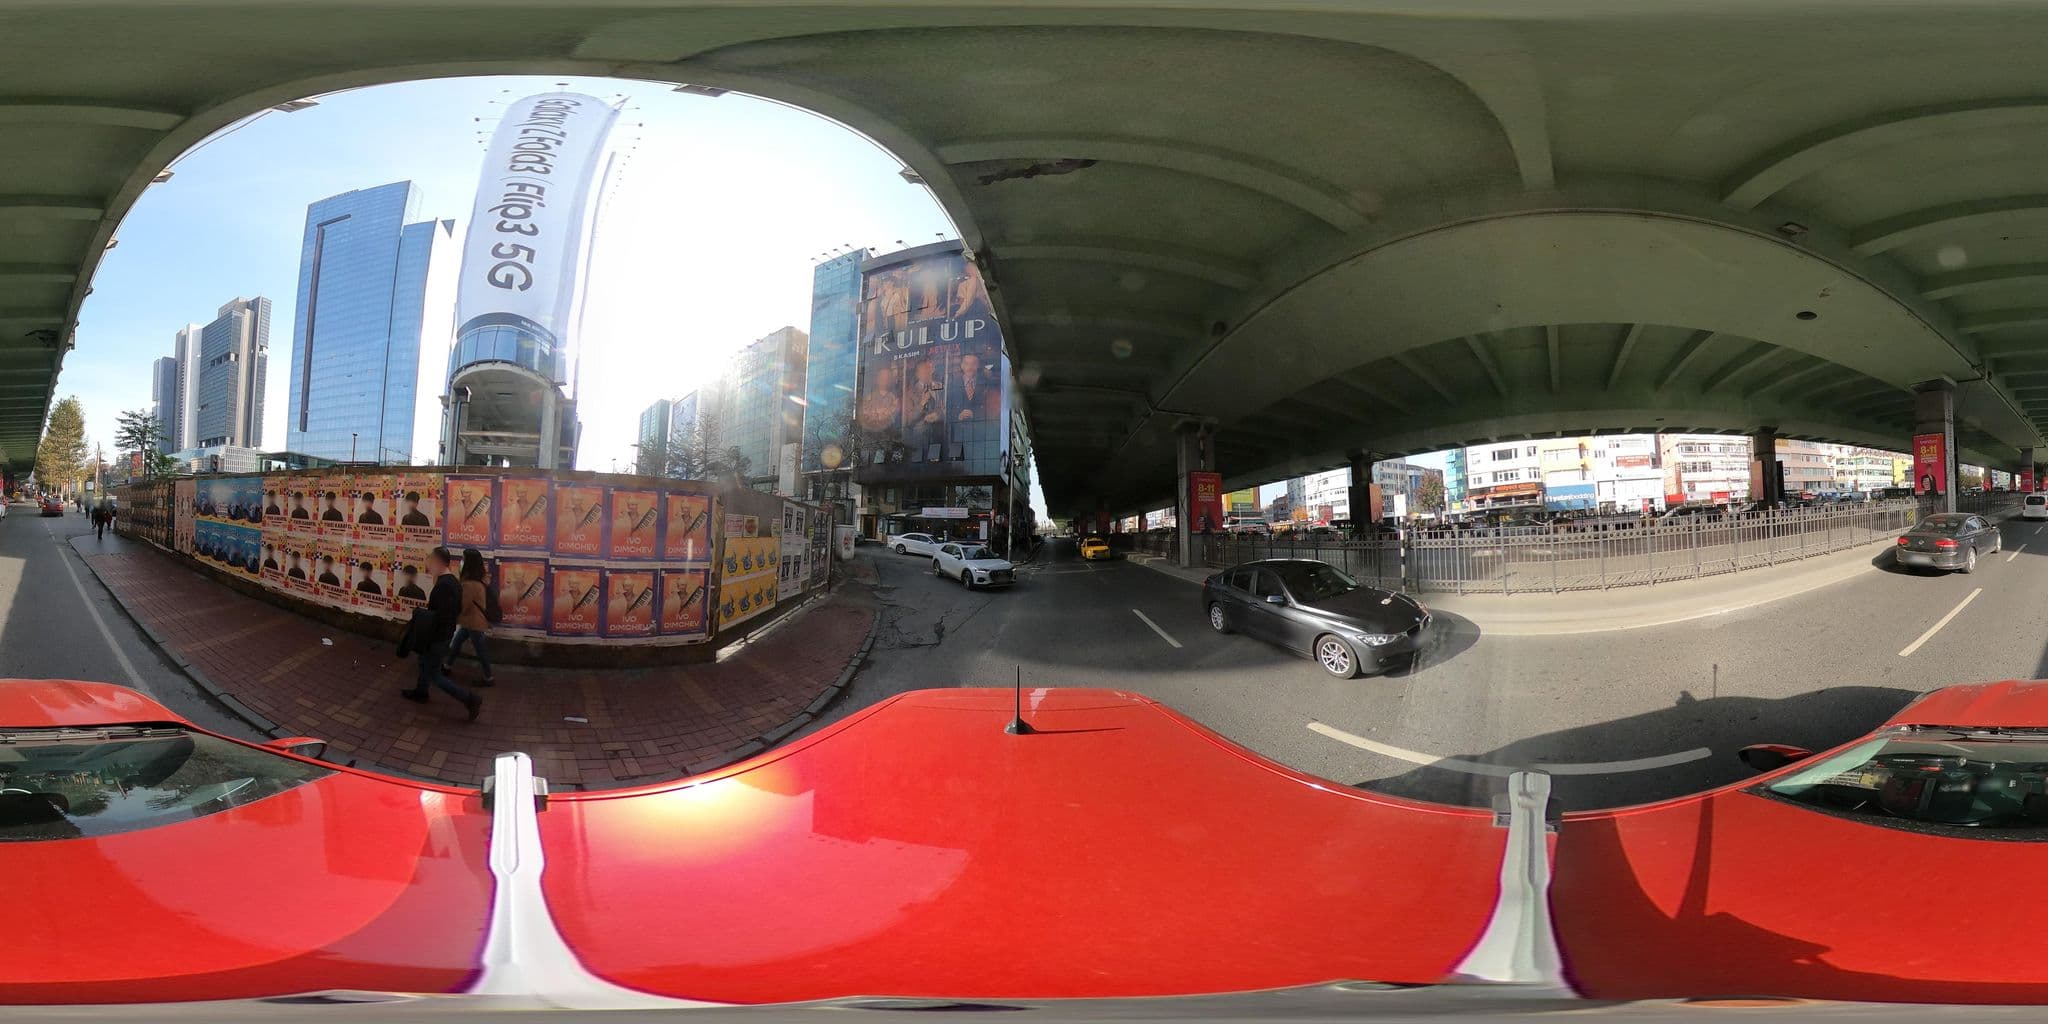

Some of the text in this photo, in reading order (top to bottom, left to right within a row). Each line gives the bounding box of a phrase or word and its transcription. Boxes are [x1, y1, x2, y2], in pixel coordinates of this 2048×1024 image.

[510, 136, 563, 174] Fold3
[488, 182, 546, 236] Flip3
[487, 242, 536, 292] 5G
[874, 318, 985, 355] KULÜP
[504, 534, 544, 542] DIMCHEV
[558, 542, 598, 551] DIMCHEV
